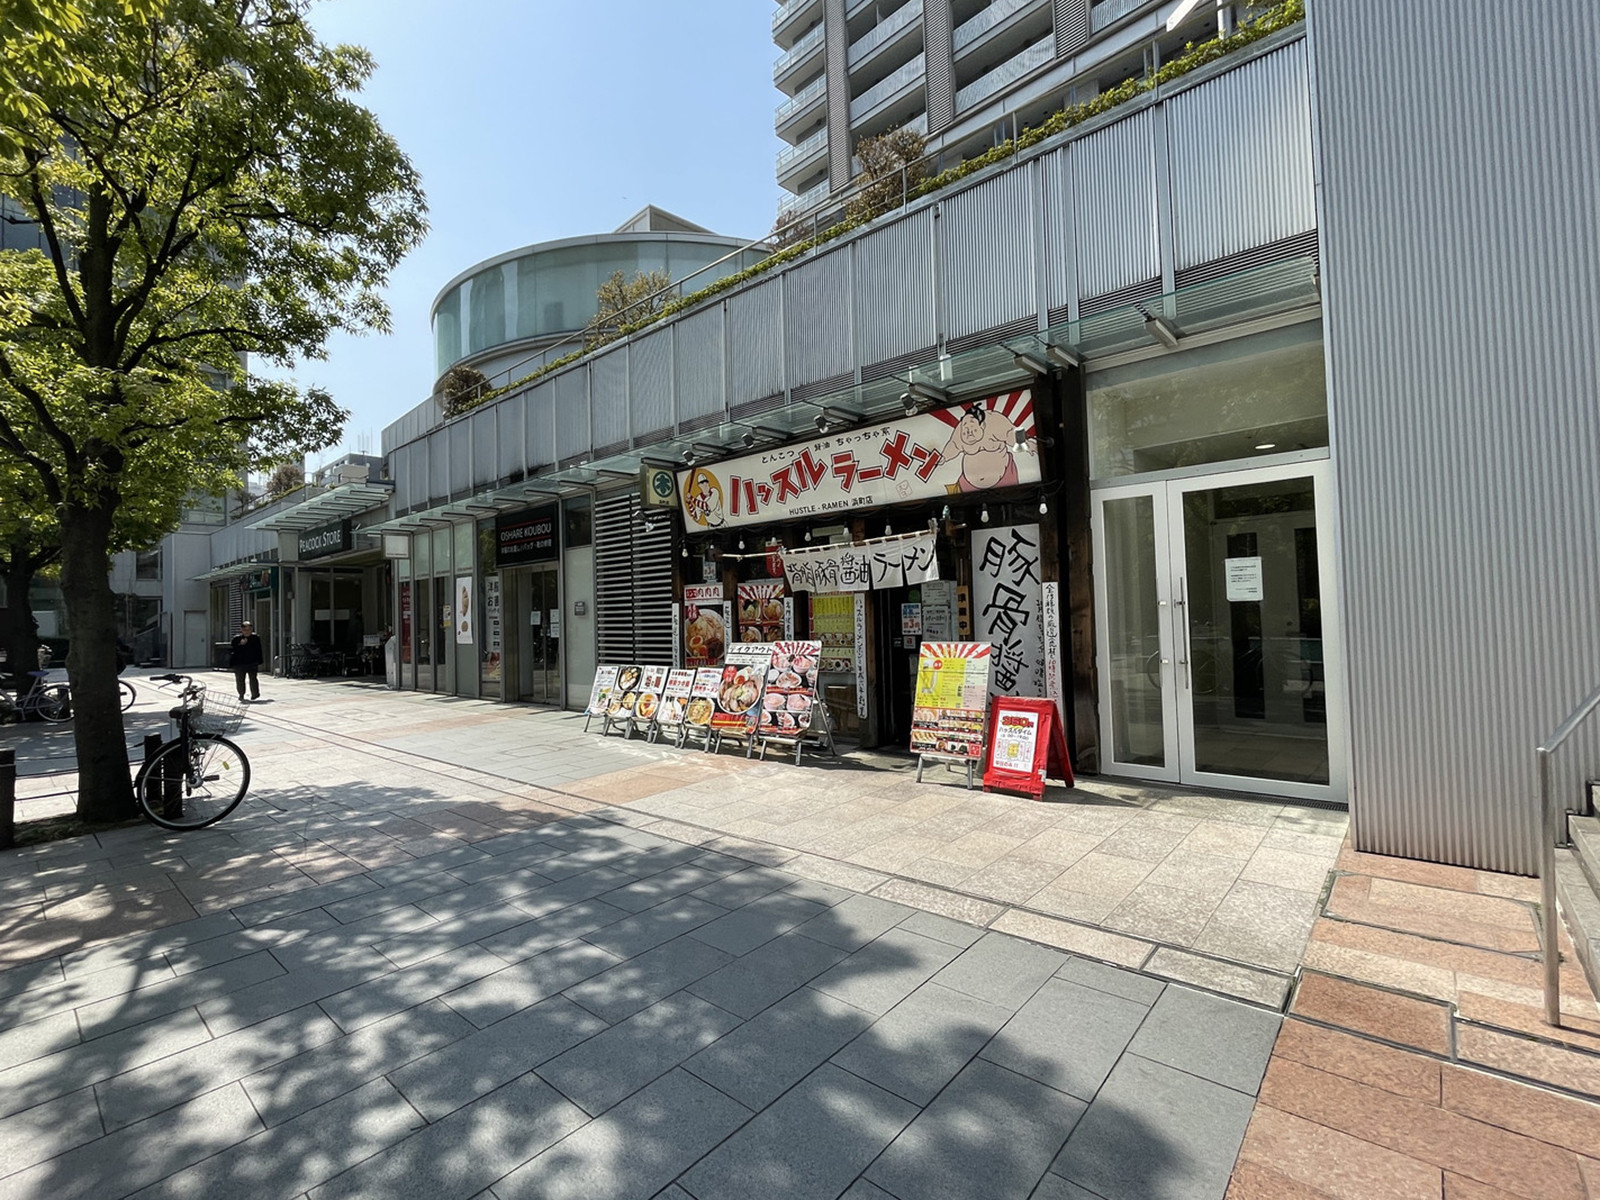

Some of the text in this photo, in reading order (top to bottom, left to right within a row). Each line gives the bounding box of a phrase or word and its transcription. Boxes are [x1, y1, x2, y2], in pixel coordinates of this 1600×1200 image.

[761, 450, 795, 464] とんこつ
[835, 426, 891, 446] ちゃっちゃ系
[729, 429, 942, 517] ハッスルラーメン
[789, 504, 816, 516] HUSTLE
[822, 500, 849, 510] RAMEN
[299, 530, 341, 553] PEACOCK STORE
[500, 522, 552, 542] OSHARE KOUBOU
[979, 528, 1040, 705] 豚骨醤
[729, 645, 773, 653] テイクアウト
